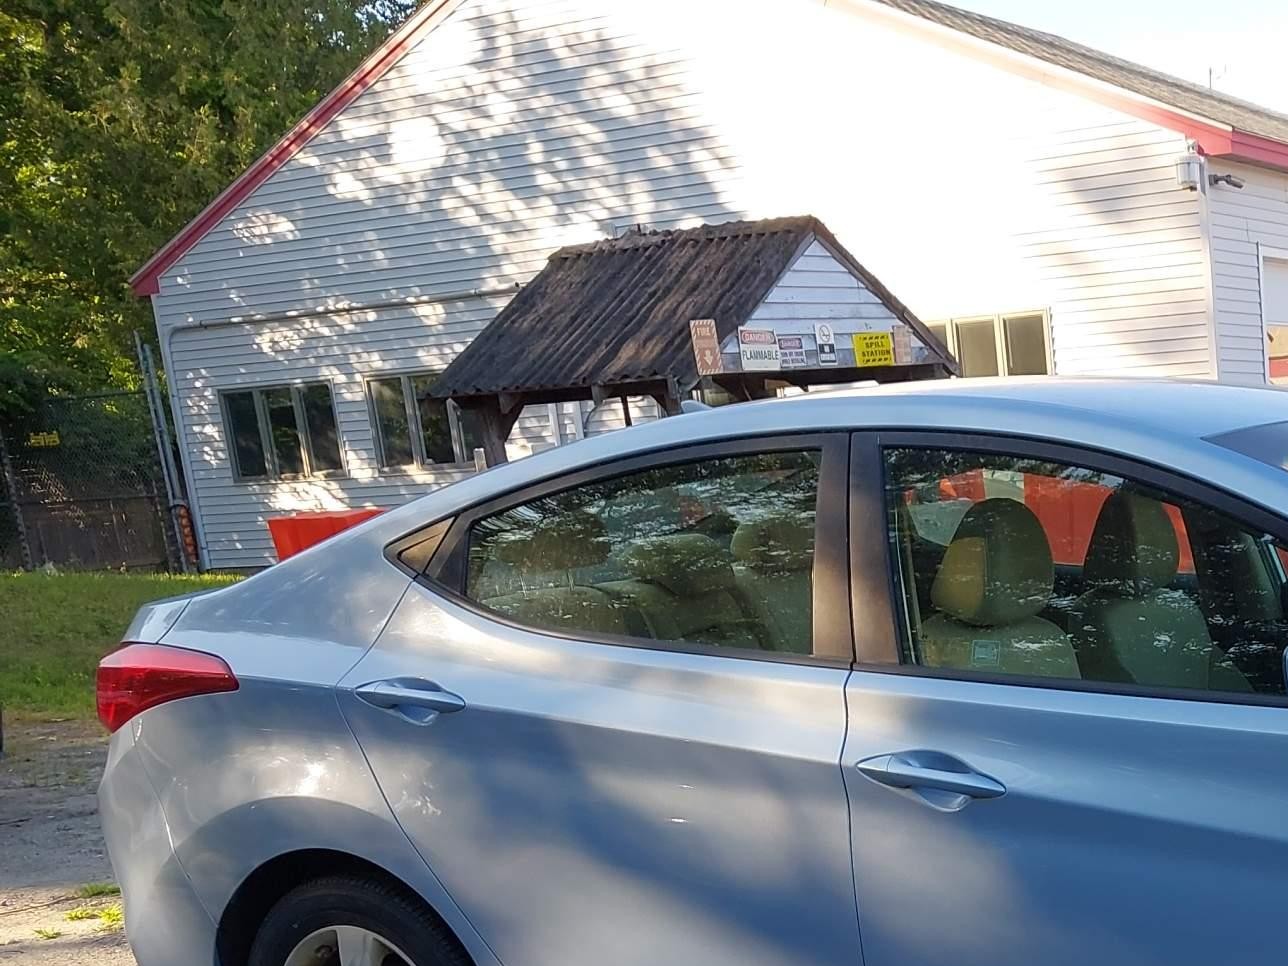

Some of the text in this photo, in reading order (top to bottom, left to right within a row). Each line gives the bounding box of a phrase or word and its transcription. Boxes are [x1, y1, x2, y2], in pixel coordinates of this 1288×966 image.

[865, 340, 885, 349] SPILL
[742, 349, 779, 360] FLAMMABLE
[862, 349, 891, 358] STATION
